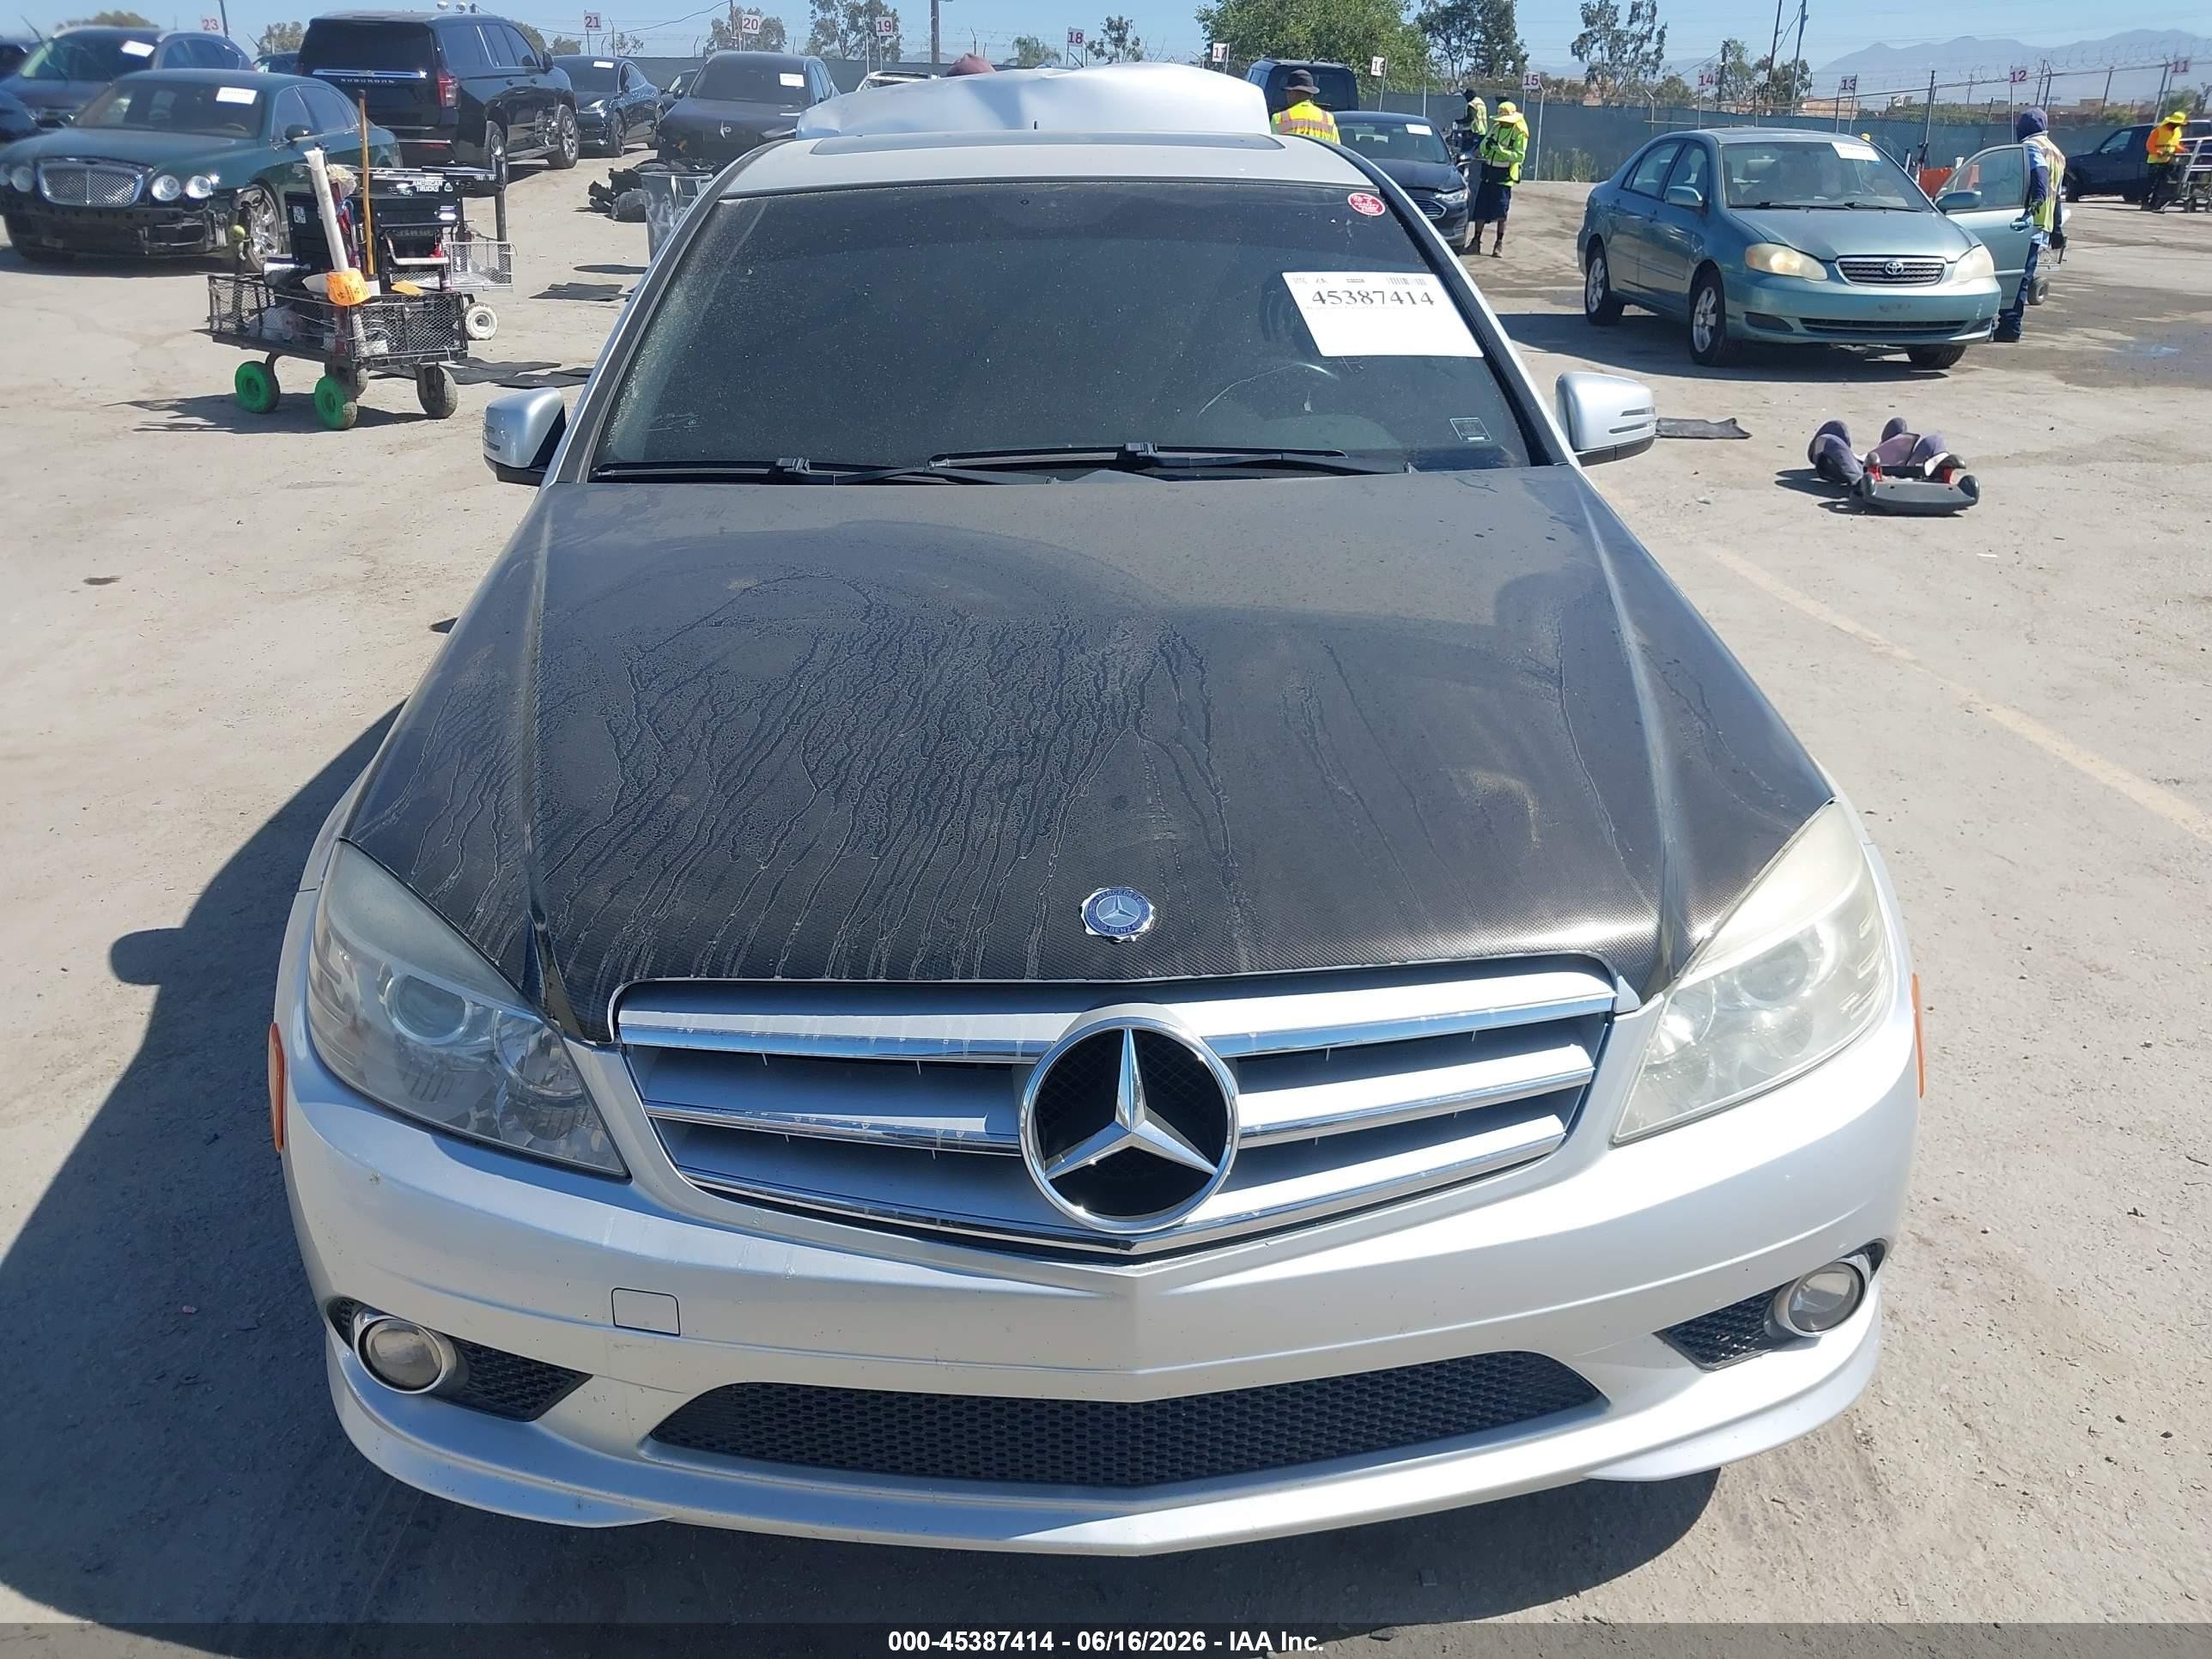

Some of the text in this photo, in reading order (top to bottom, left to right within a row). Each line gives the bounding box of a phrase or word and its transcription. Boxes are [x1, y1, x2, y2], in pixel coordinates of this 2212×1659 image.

[202, 19, 219, 31] 23
[585, 15, 601, 28] 21
[743, 17, 759, 31] 20
[877, 20, 892, 33] 19
[1067, 32, 1083, 44] 18
[2172, 60, 2189, 73] 11
[1523, 74, 1539, 86] 15
[1698, 74, 1714, 86] 14
[2009, 70, 2027, 83] 12
[1841, 78, 1856, 90] 13
[1312, 290, 1434, 306] 45387414
